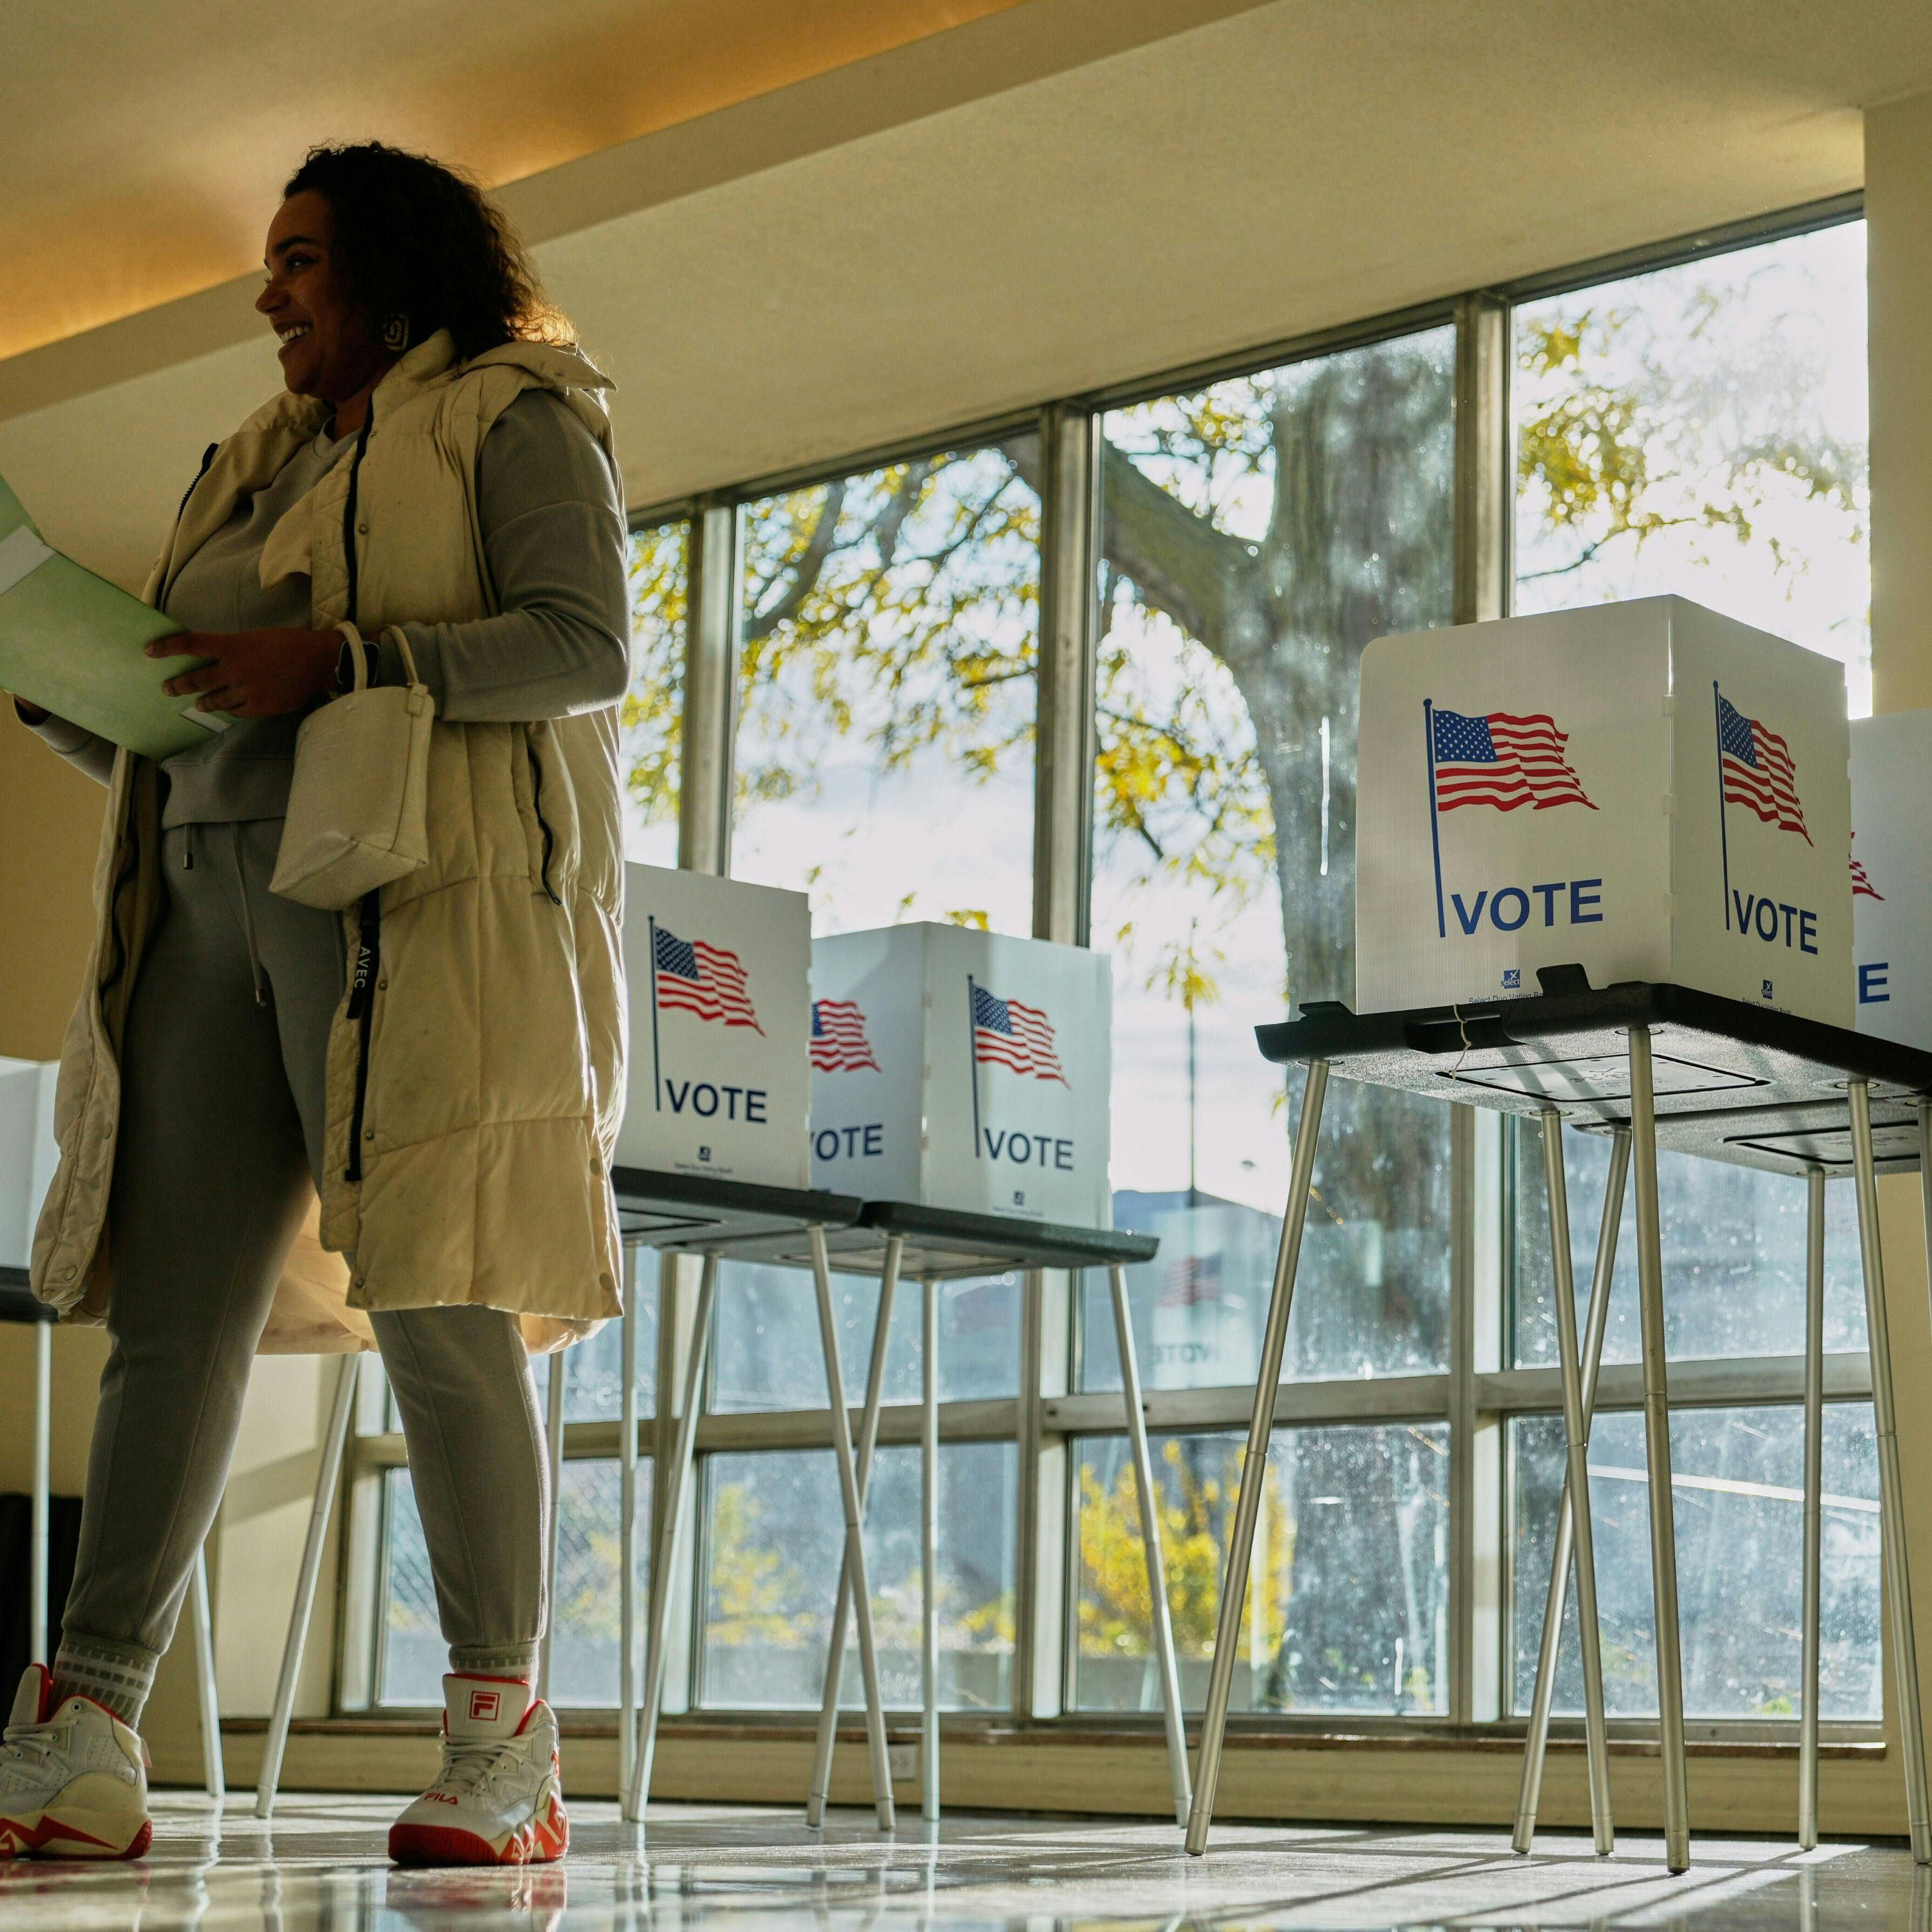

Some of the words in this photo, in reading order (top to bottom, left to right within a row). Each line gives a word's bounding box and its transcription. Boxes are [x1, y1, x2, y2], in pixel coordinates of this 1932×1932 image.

[1451, 878, 1603, 935] VOTE
[1733, 889, 1818, 954] VOTE
[354, 946, 372, 988] AVEC
[1501, 978, 1520, 987] select
[665, 1079, 766, 1124] VOTE
[810, 1124, 884, 1160] OTE
[984, 1128, 1074, 1171] VOTE
[424, 1793, 458, 1805] FILA
